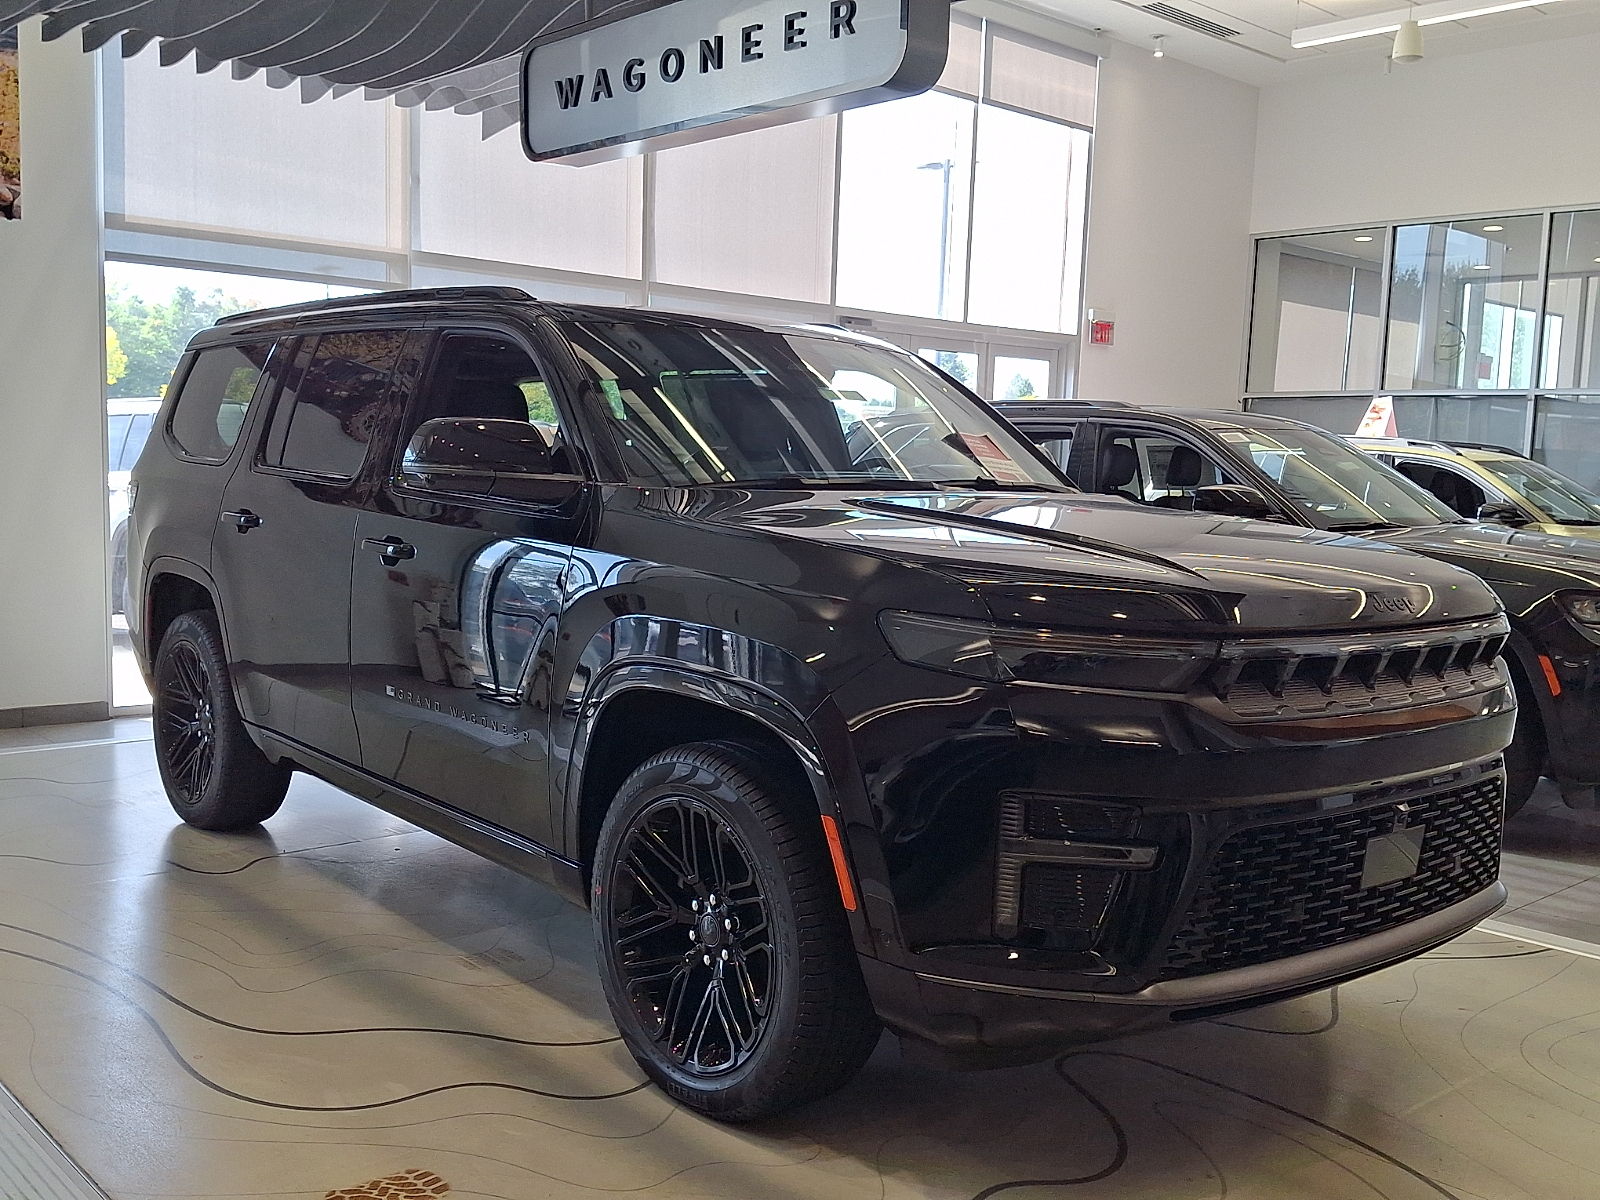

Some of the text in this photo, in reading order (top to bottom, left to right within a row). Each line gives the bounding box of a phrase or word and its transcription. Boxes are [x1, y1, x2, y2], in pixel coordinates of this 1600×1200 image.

[554, 0, 857, 110] WAGONEER
[1373, 594, 1416, 614] Jeep
[397, 689, 530, 744] GRAND WAGONEER
